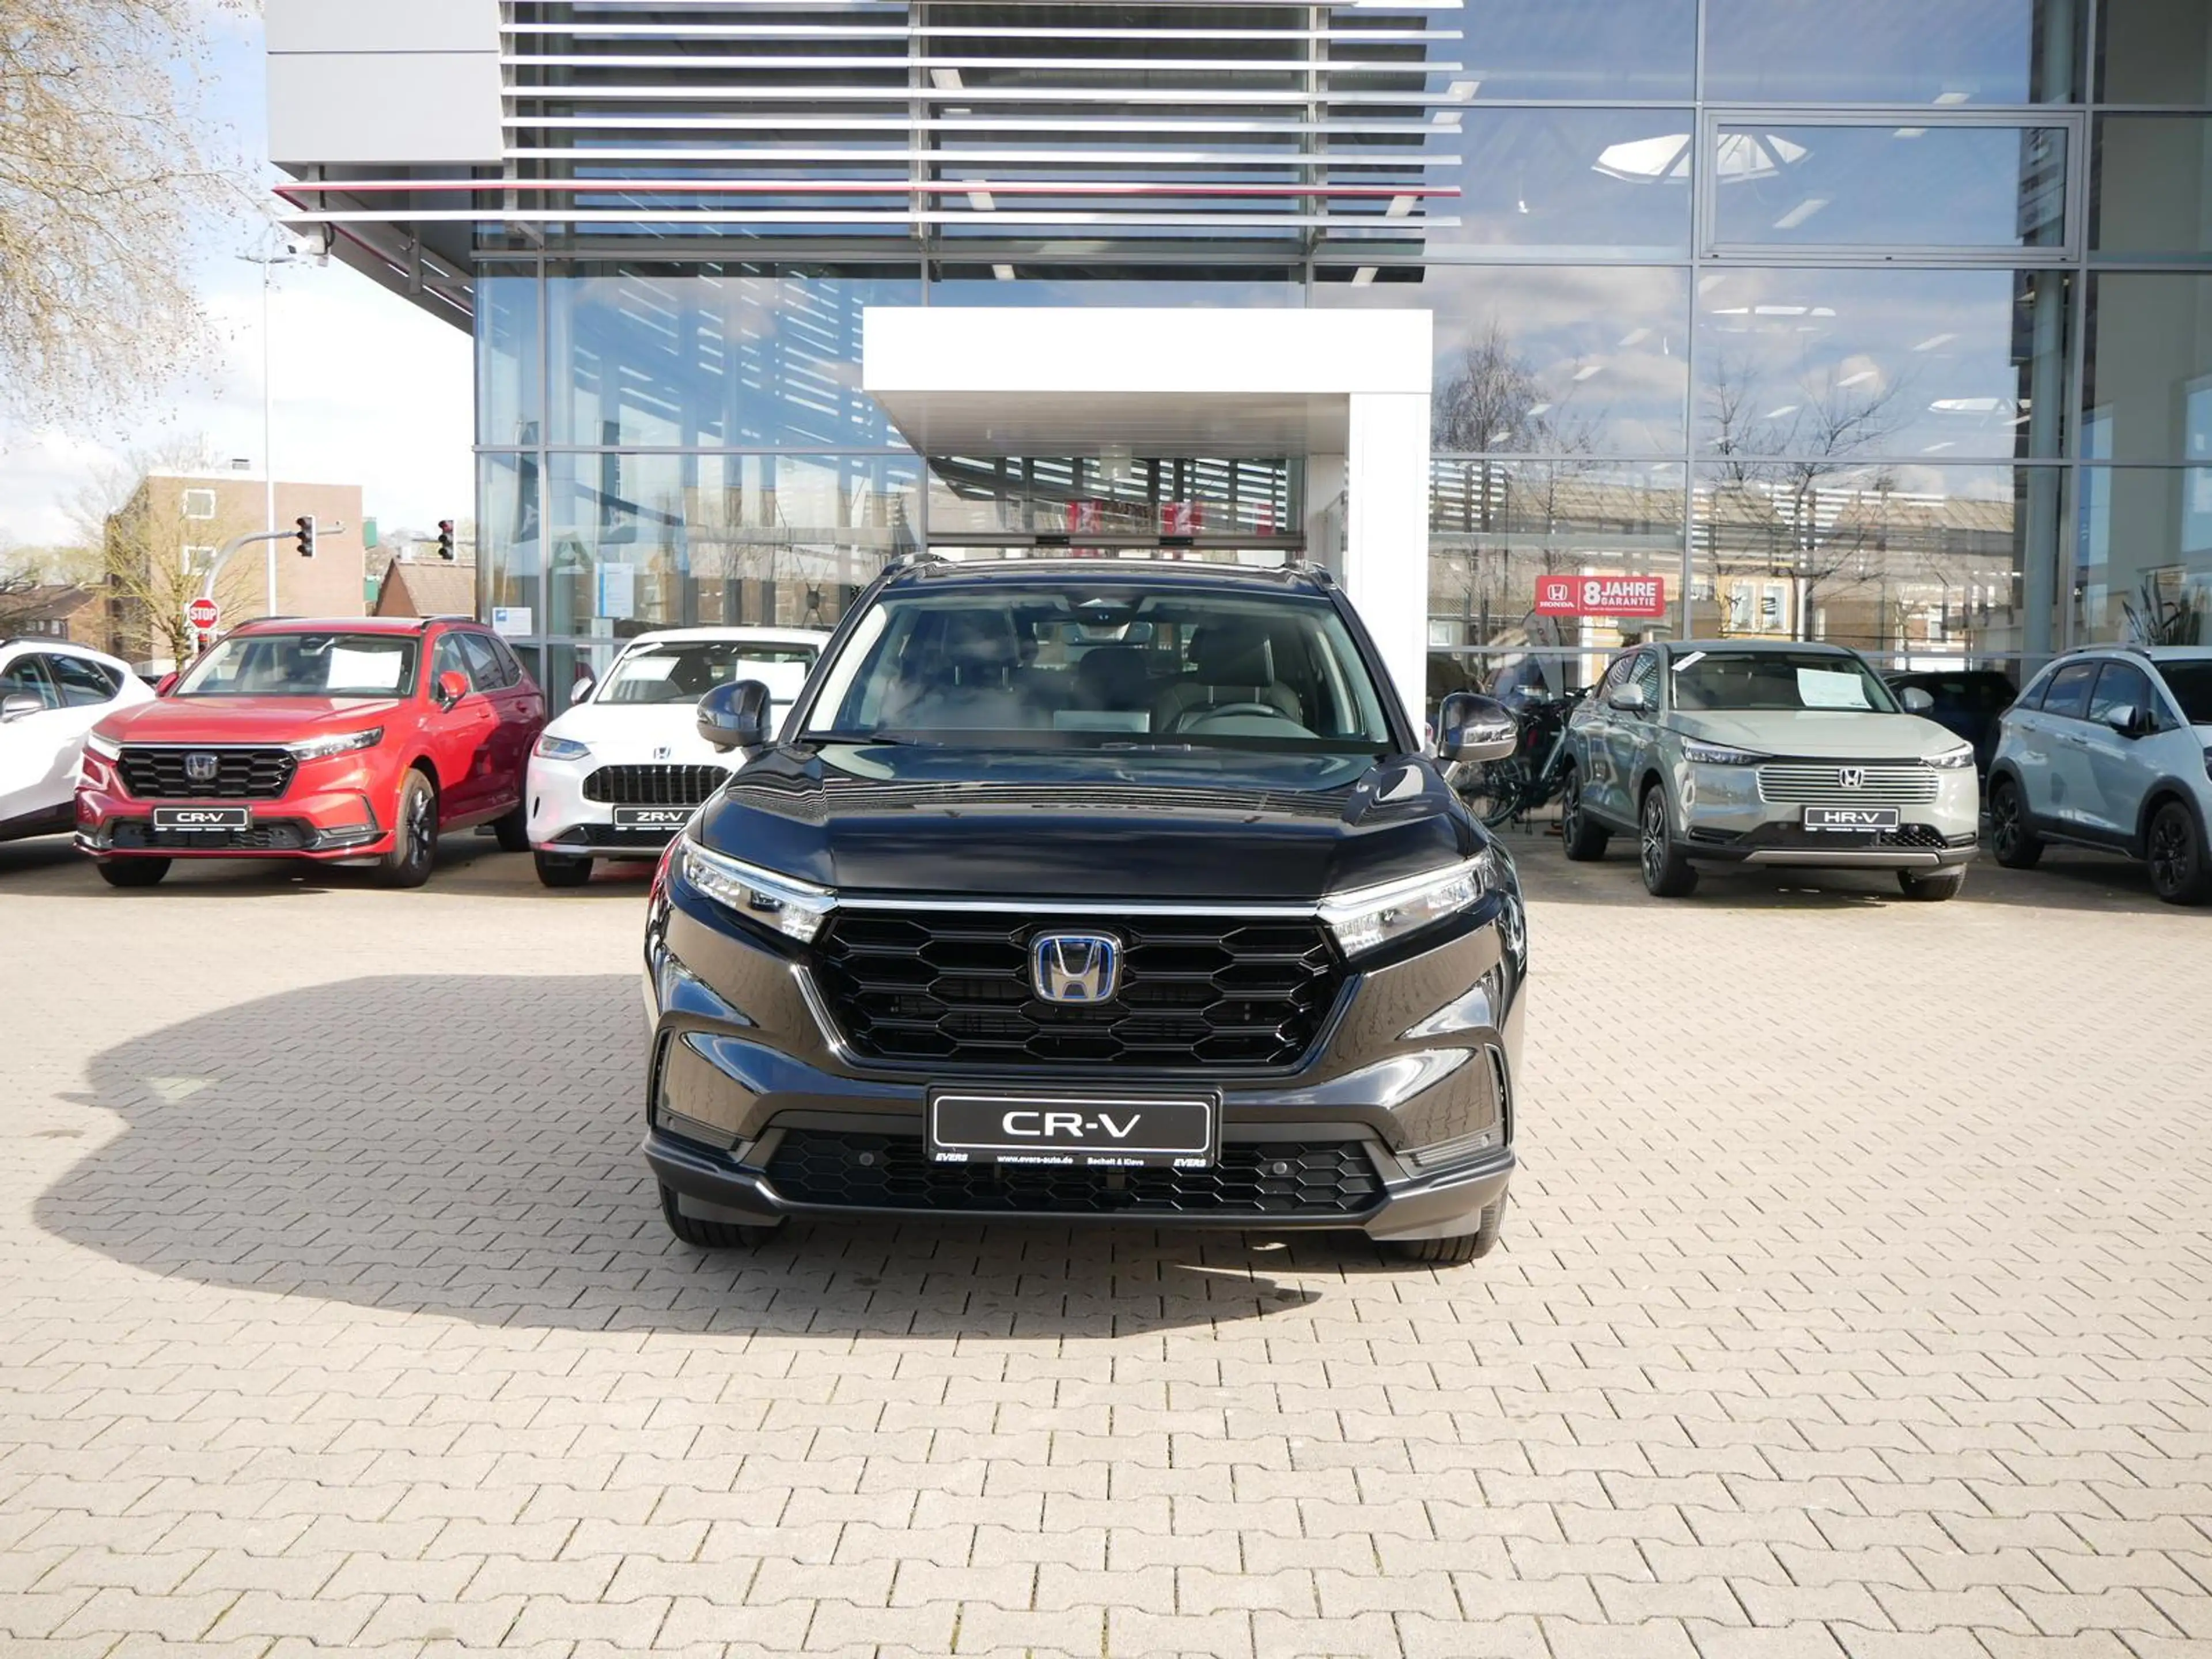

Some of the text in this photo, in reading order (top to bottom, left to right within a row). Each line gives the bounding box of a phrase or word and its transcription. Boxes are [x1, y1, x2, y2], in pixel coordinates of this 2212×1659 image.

[1584, 581, 1657, 605] 8 JAHRE
[1601, 597, 1656, 607] GARANTIE
[190, 607, 217, 620] STOP
[176, 812, 224, 823] CR-V
[637, 812, 684, 822] ZR-V
[1824, 811, 1880, 823] HR-V
[1002, 1111, 1141, 1138] CR-V
[935, 1153, 968, 1162] EVERS
[1173, 1158, 1207, 1167] EVERS
